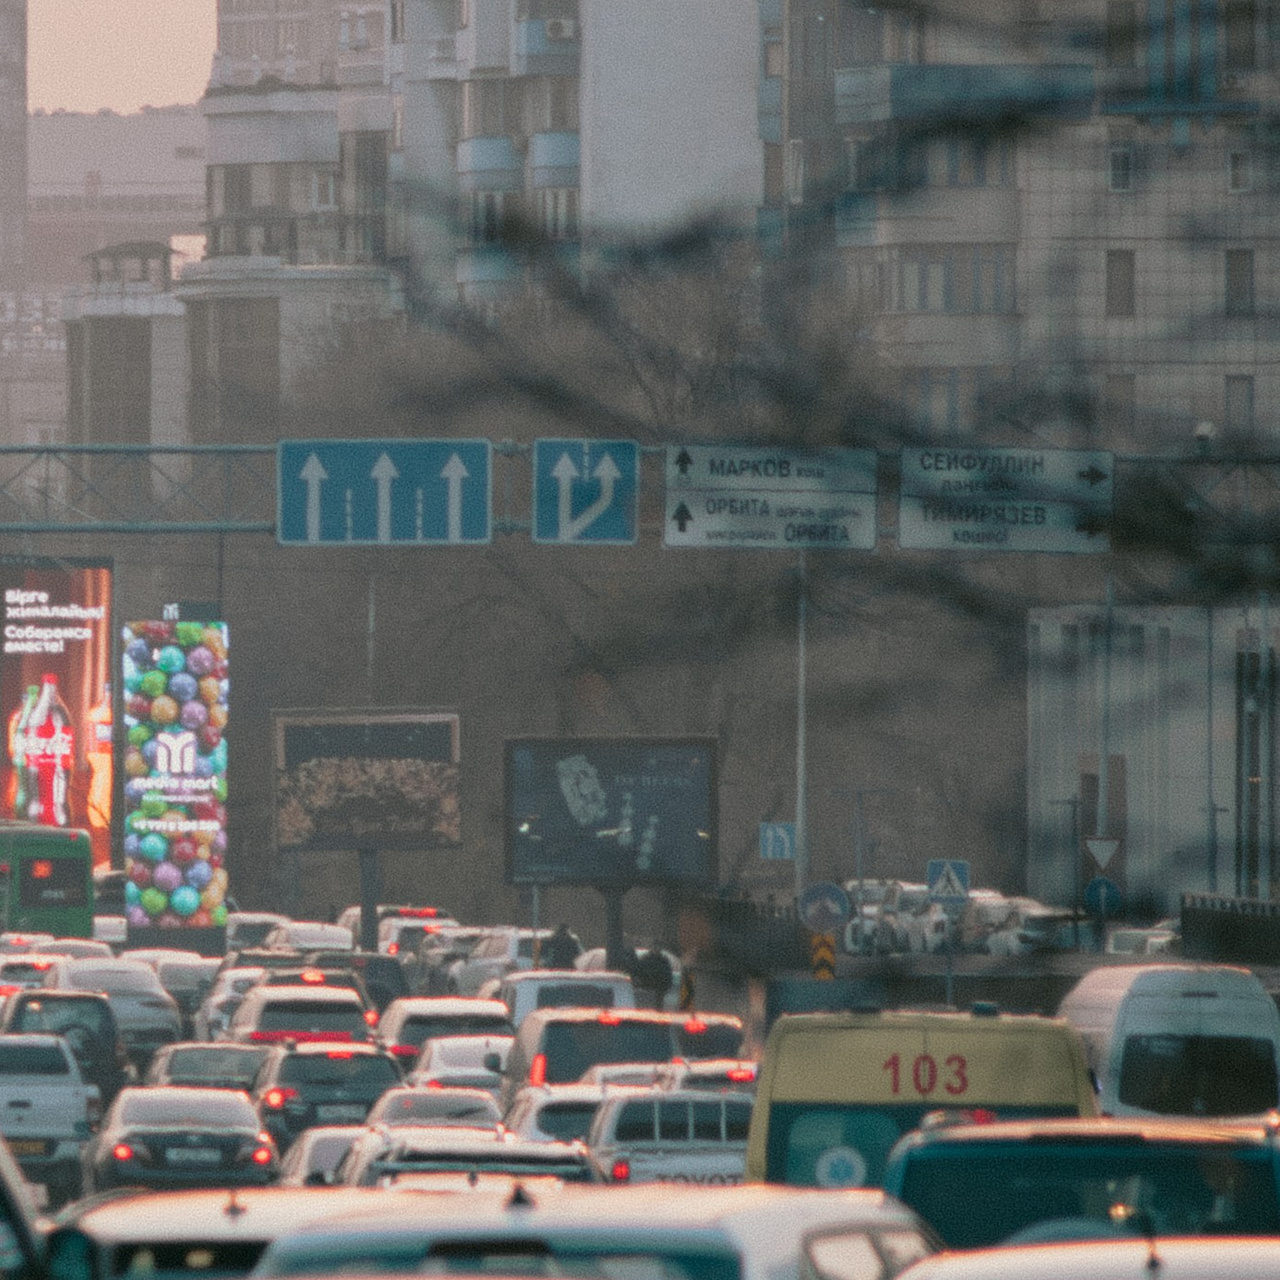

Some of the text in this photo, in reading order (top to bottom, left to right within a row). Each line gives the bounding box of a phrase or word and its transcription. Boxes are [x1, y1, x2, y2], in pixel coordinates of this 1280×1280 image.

[709, 458, 791, 478] МАРКОВ
[705, 497, 770, 517] ОРБИТА
[783, 521, 850, 543] ОРБИТА
[882, 1053, 970, 1096] 103
[655, 1172, 744, 1188] TOYOT
